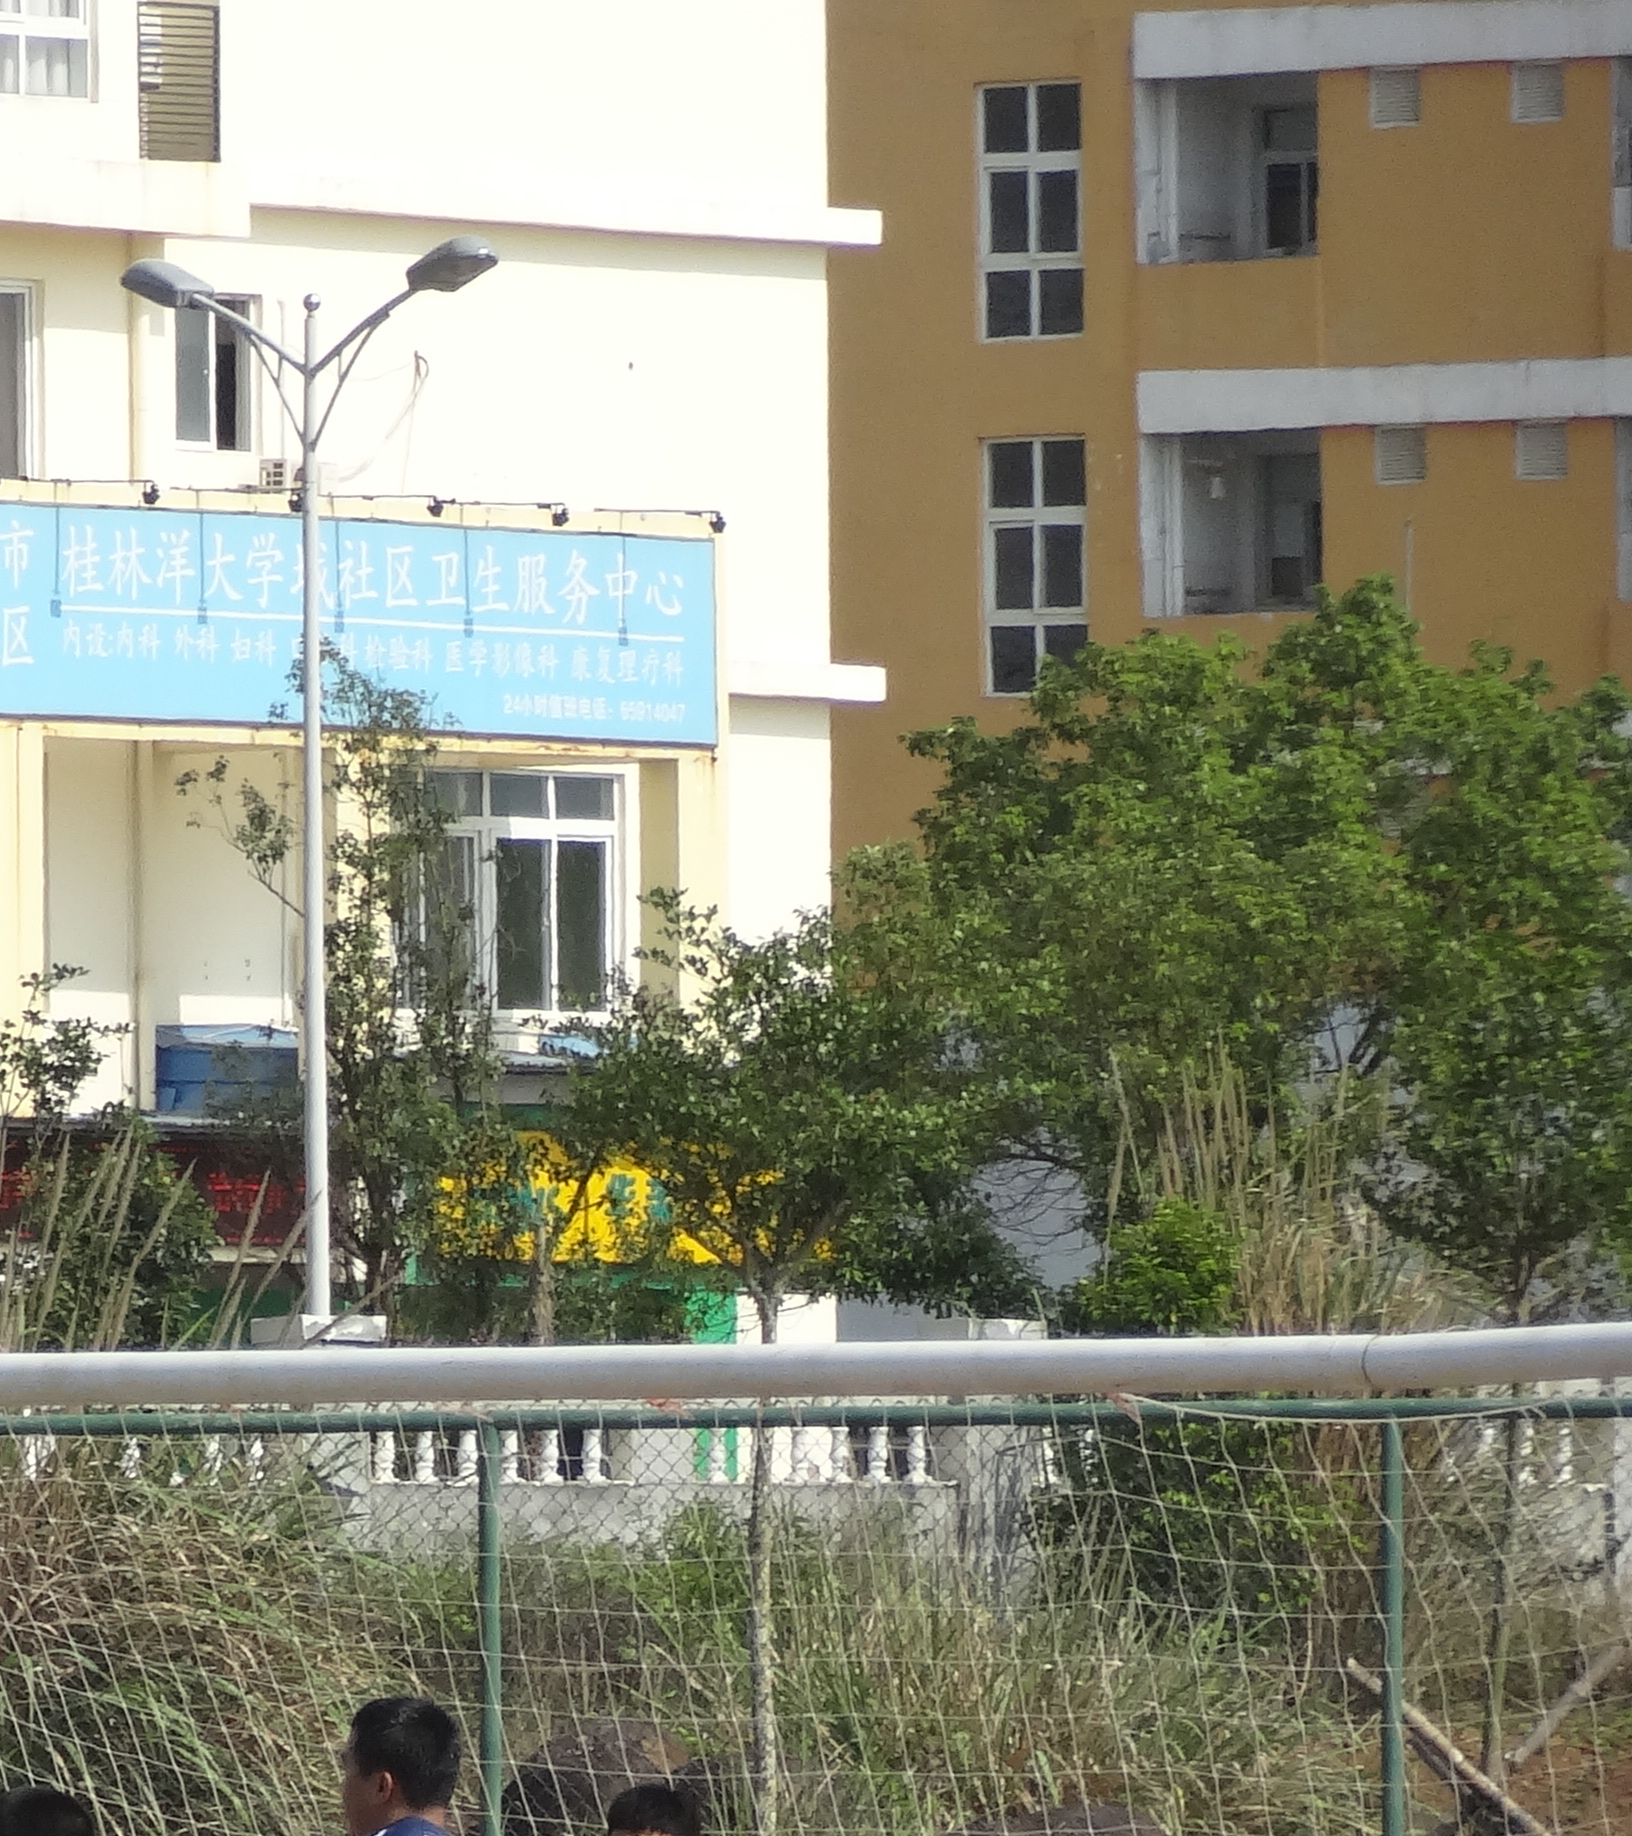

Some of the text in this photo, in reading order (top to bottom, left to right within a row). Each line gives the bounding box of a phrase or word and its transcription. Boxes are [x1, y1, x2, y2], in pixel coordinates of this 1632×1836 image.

[61, 523, 685, 627] 桂林洋大学城社区卫生服务中心
